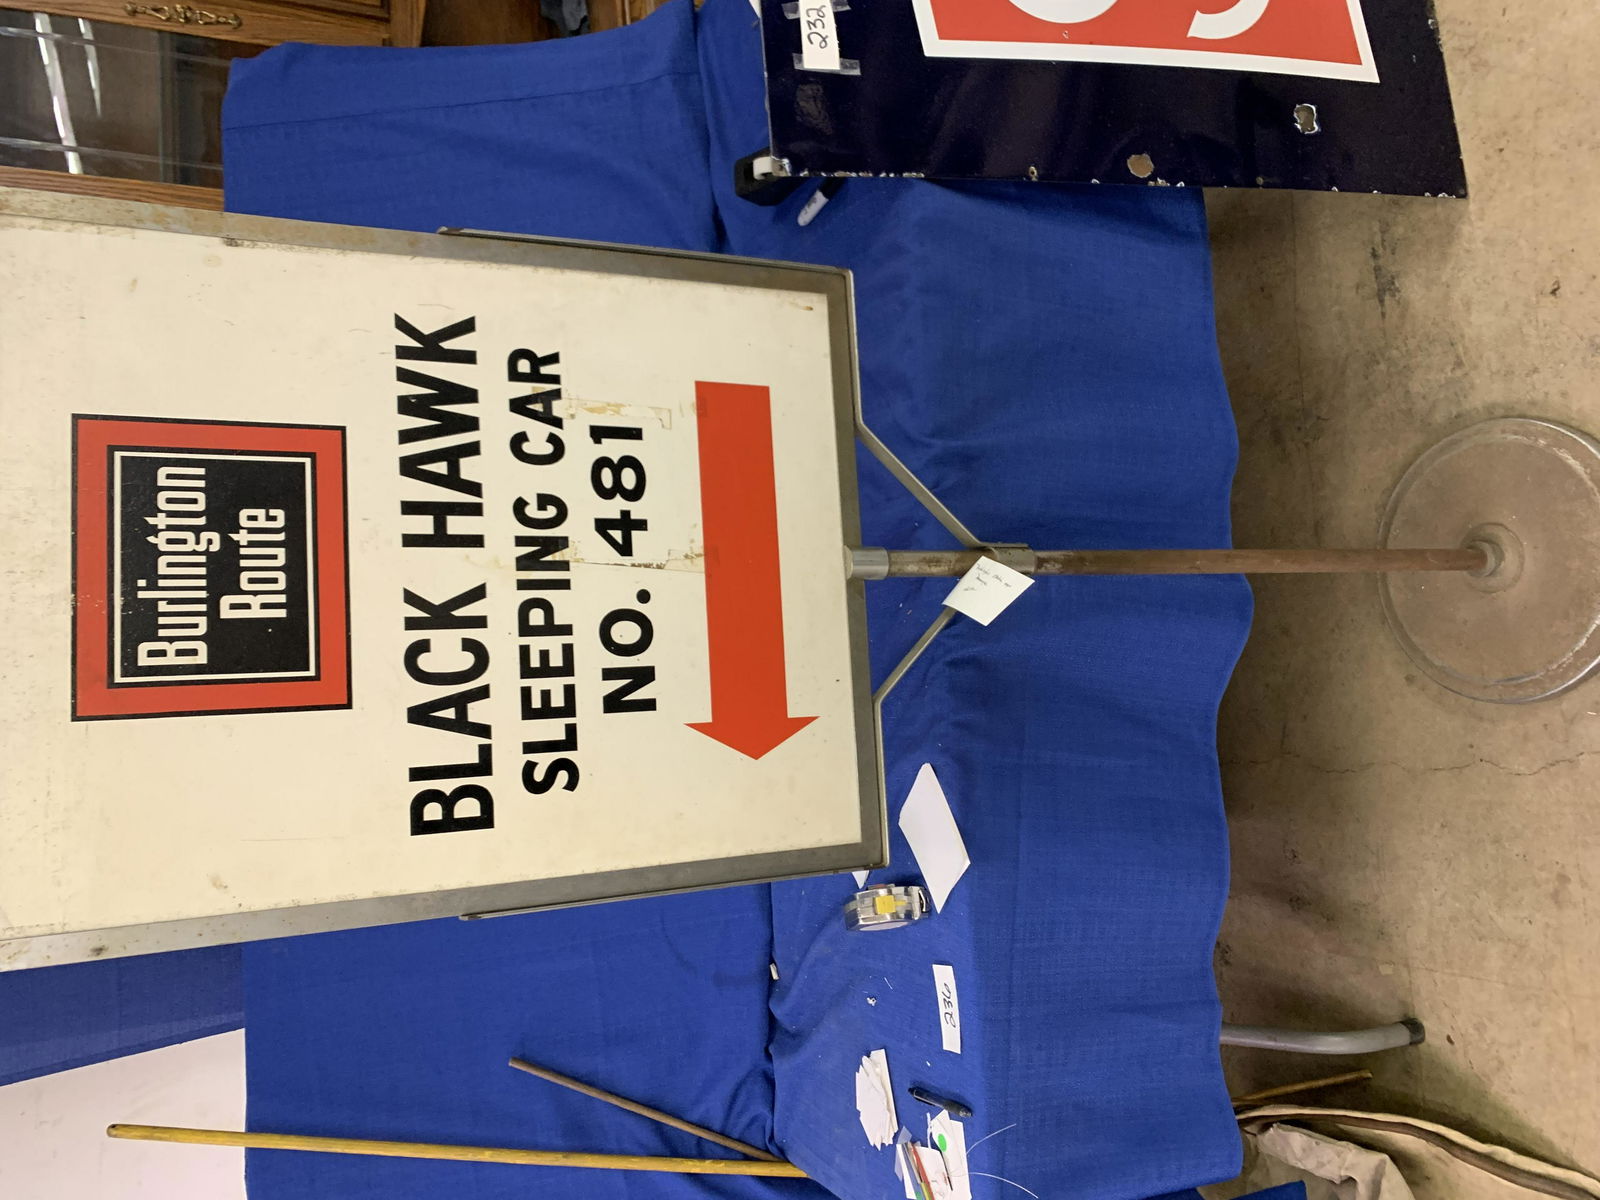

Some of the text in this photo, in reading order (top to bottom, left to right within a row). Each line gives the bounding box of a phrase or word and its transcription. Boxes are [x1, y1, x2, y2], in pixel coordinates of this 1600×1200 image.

[806, 5, 828, 49] 232
[136, 466, 221, 667] Burlington
[220, 508, 287, 619] Route
[394, 313, 495, 837] BLACK HAWK
[507, 348, 580, 795] SLEEPING CAR
[589, 424, 657, 714] NO. 481
[942, 983, 957, 1028] 236
